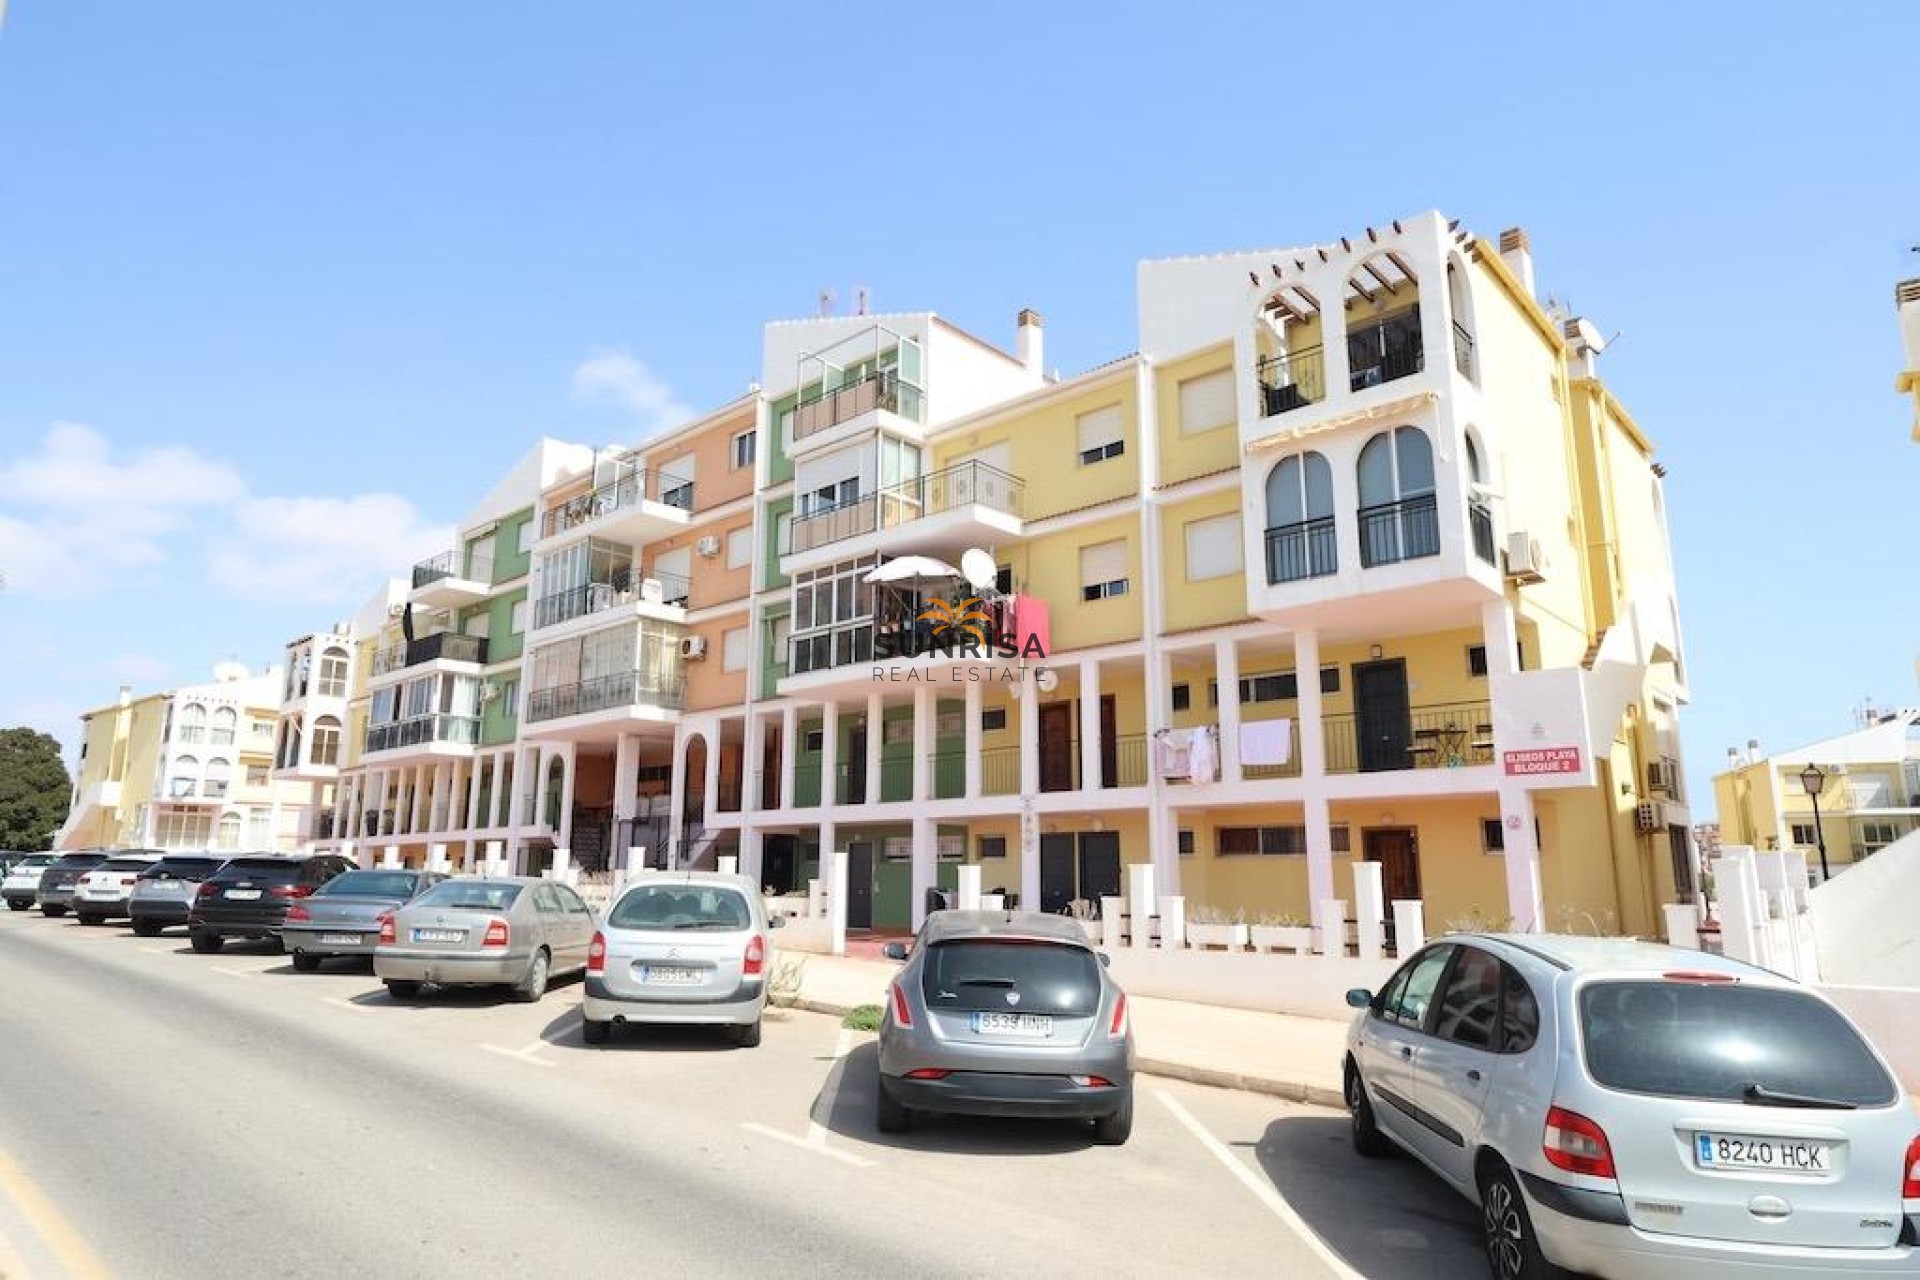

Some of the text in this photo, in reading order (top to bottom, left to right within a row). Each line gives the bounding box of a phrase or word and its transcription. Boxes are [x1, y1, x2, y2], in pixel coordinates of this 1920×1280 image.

[1547, 749, 1576, 761] PLAYA
[1514, 760, 1561, 773] BLOQUE
[1718, 1138, 1822, 1168] 8240 HCK
